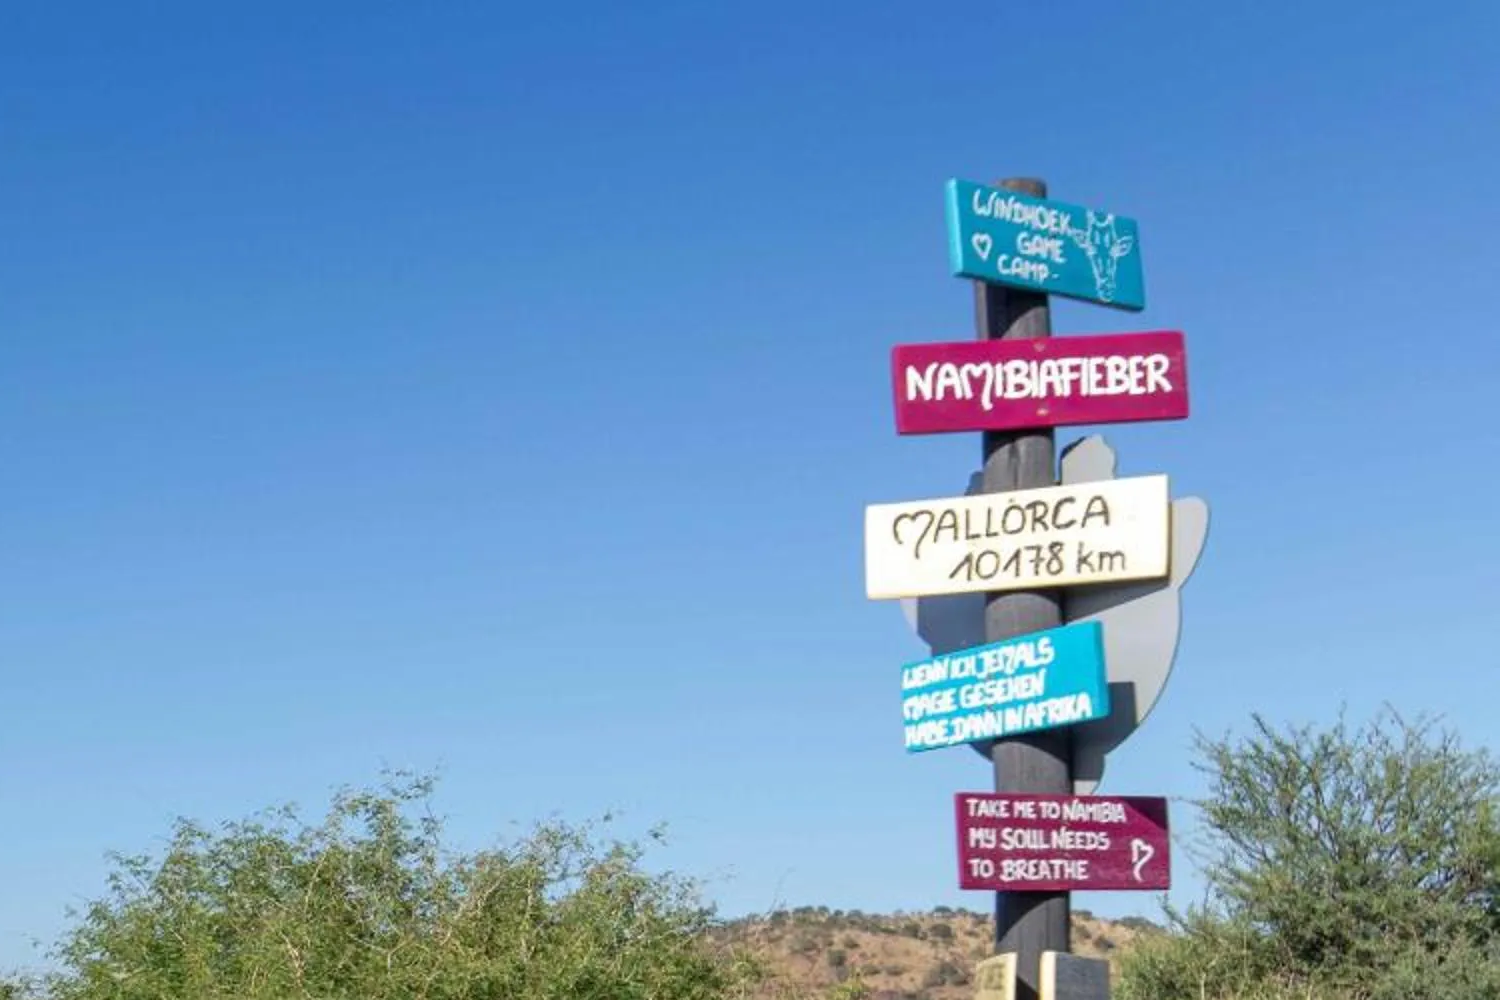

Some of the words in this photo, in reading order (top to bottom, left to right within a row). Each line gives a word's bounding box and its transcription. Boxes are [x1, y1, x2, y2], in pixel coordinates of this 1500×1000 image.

[972, 187, 1071, 235] WINDHOEK
[1016, 232, 1066, 263] GAME
[905, 354, 1173, 410] NAMIBIAFIEBER
[893, 496, 1110, 559] MALLORCA
[949, 542, 1064, 581] 10178
[1076, 542, 1126, 573] km
[959, 668, 1047, 708] GESEHEN
[1024, 691, 1092, 728] AFRIKA
[966, 799, 1010, 818] TAKE
[1014, 801, 1038, 820] ME
[1040, 802, 1061, 819] TO
[1063, 798, 1127, 823] NAMIBIA
[969, 827, 997, 848] MY
[1001, 828, 1049, 850] SOUL
[1050, 826, 1111, 850] NEEDS
[969, 859, 995, 878] TO
[1000, 859, 1089, 882] BREATHE
